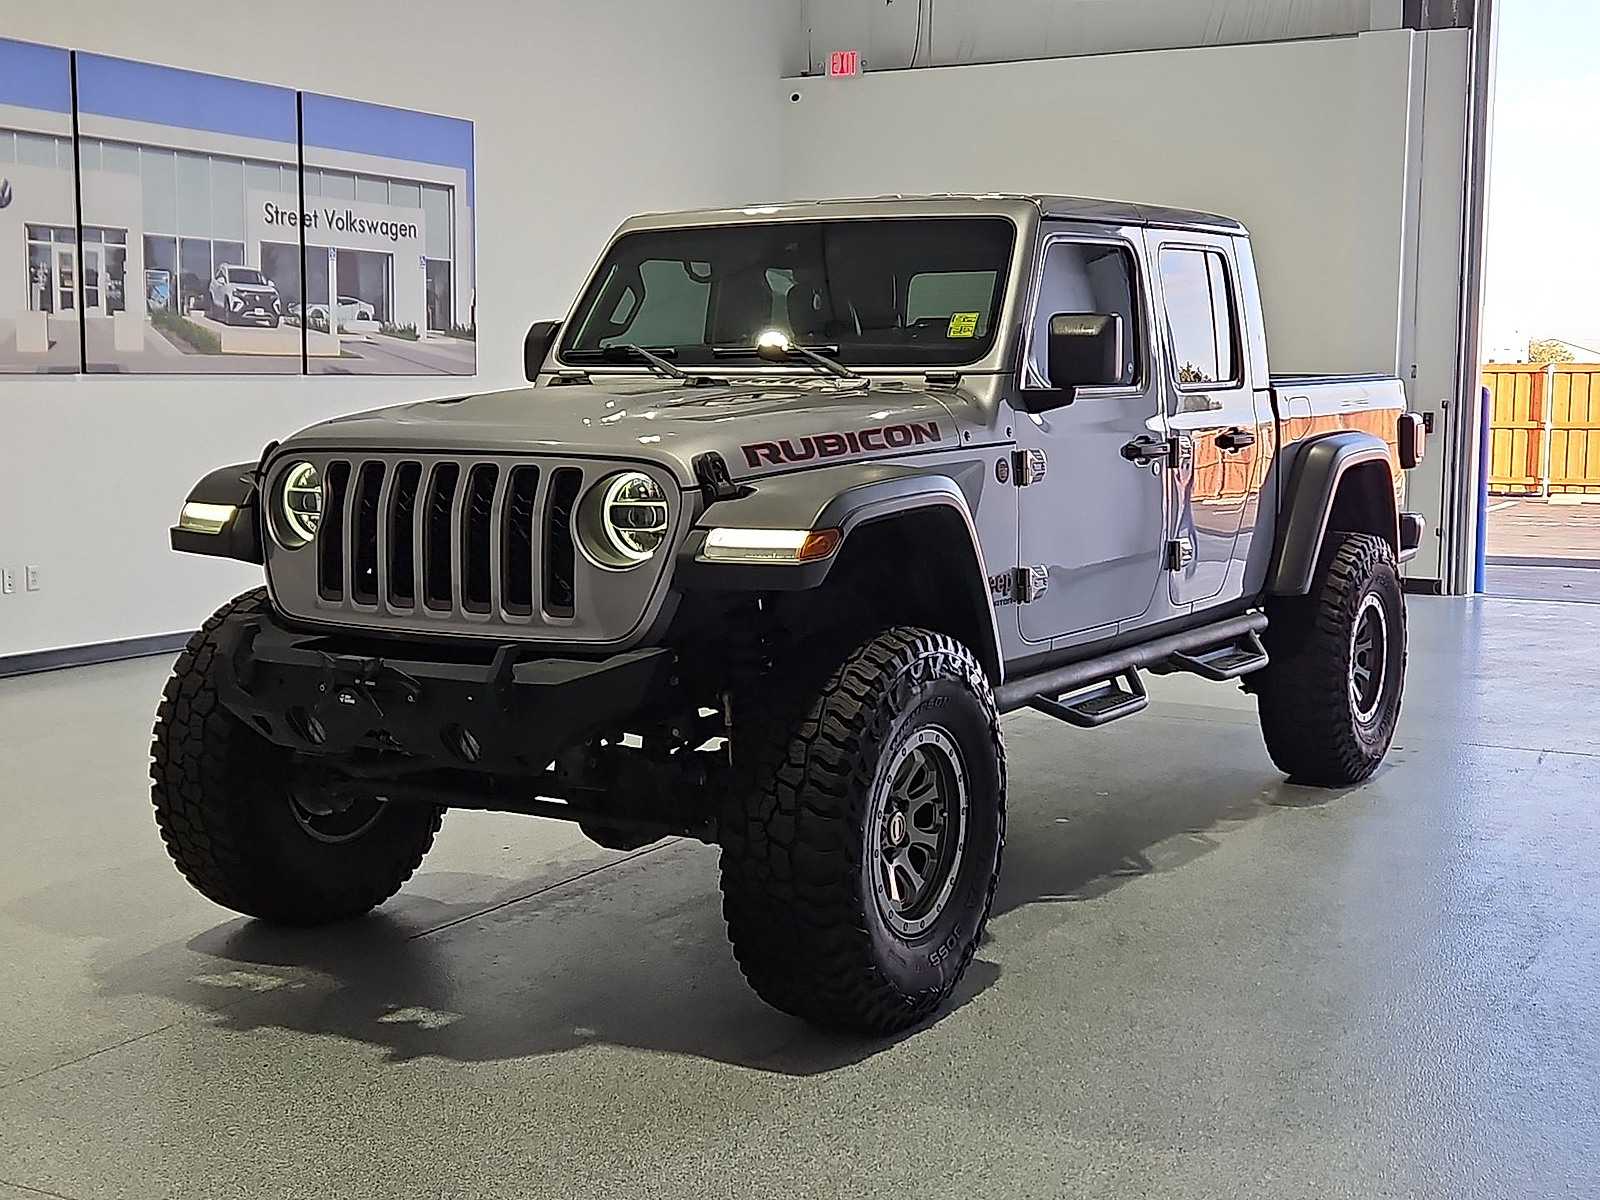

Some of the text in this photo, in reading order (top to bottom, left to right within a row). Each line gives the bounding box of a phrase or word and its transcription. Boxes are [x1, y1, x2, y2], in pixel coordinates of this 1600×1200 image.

[831, 52, 857, 75] EXIT
[264, 202, 418, 241] Street Volkswagen
[741, 421, 942, 469] RUBICON
[988, 573, 1012, 596] eep
